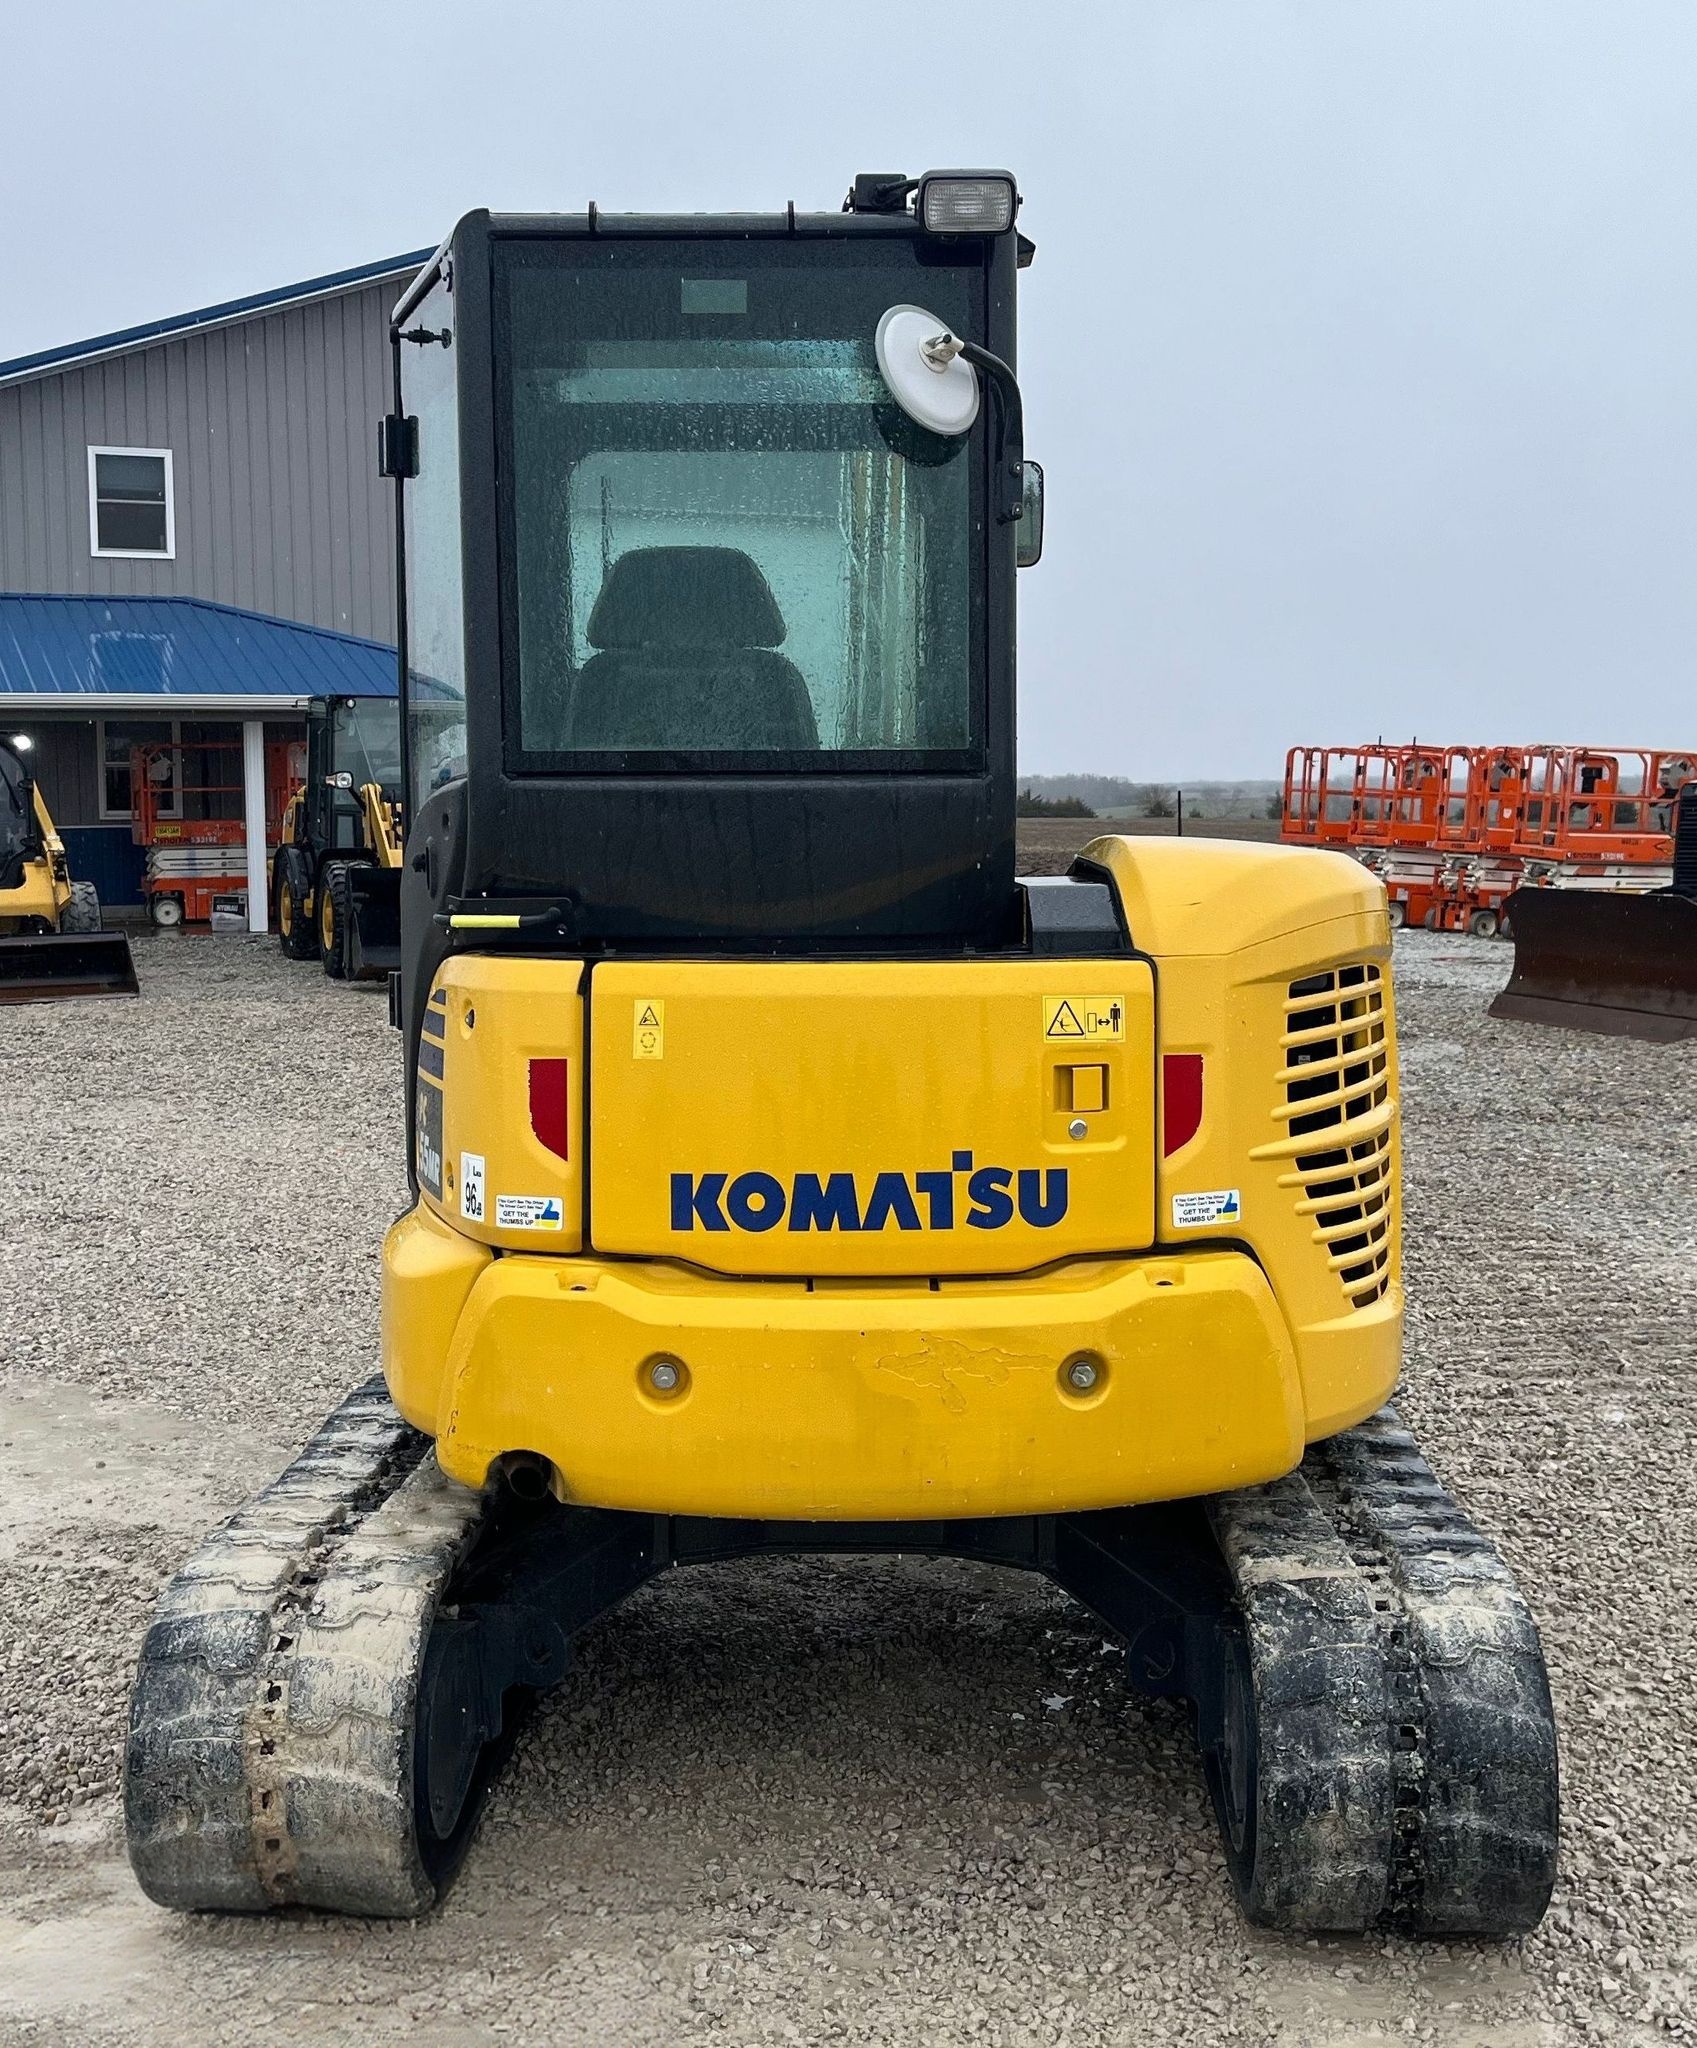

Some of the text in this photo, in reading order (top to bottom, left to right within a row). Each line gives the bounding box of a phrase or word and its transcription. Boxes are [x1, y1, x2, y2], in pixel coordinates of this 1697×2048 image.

[465, 1182, 477, 1215] 96
[670, 1150, 1068, 1232] KOMATSU
[1179, 1215, 1205, 1223] THUMBS
[1183, 1208, 1196, 1216] GET
